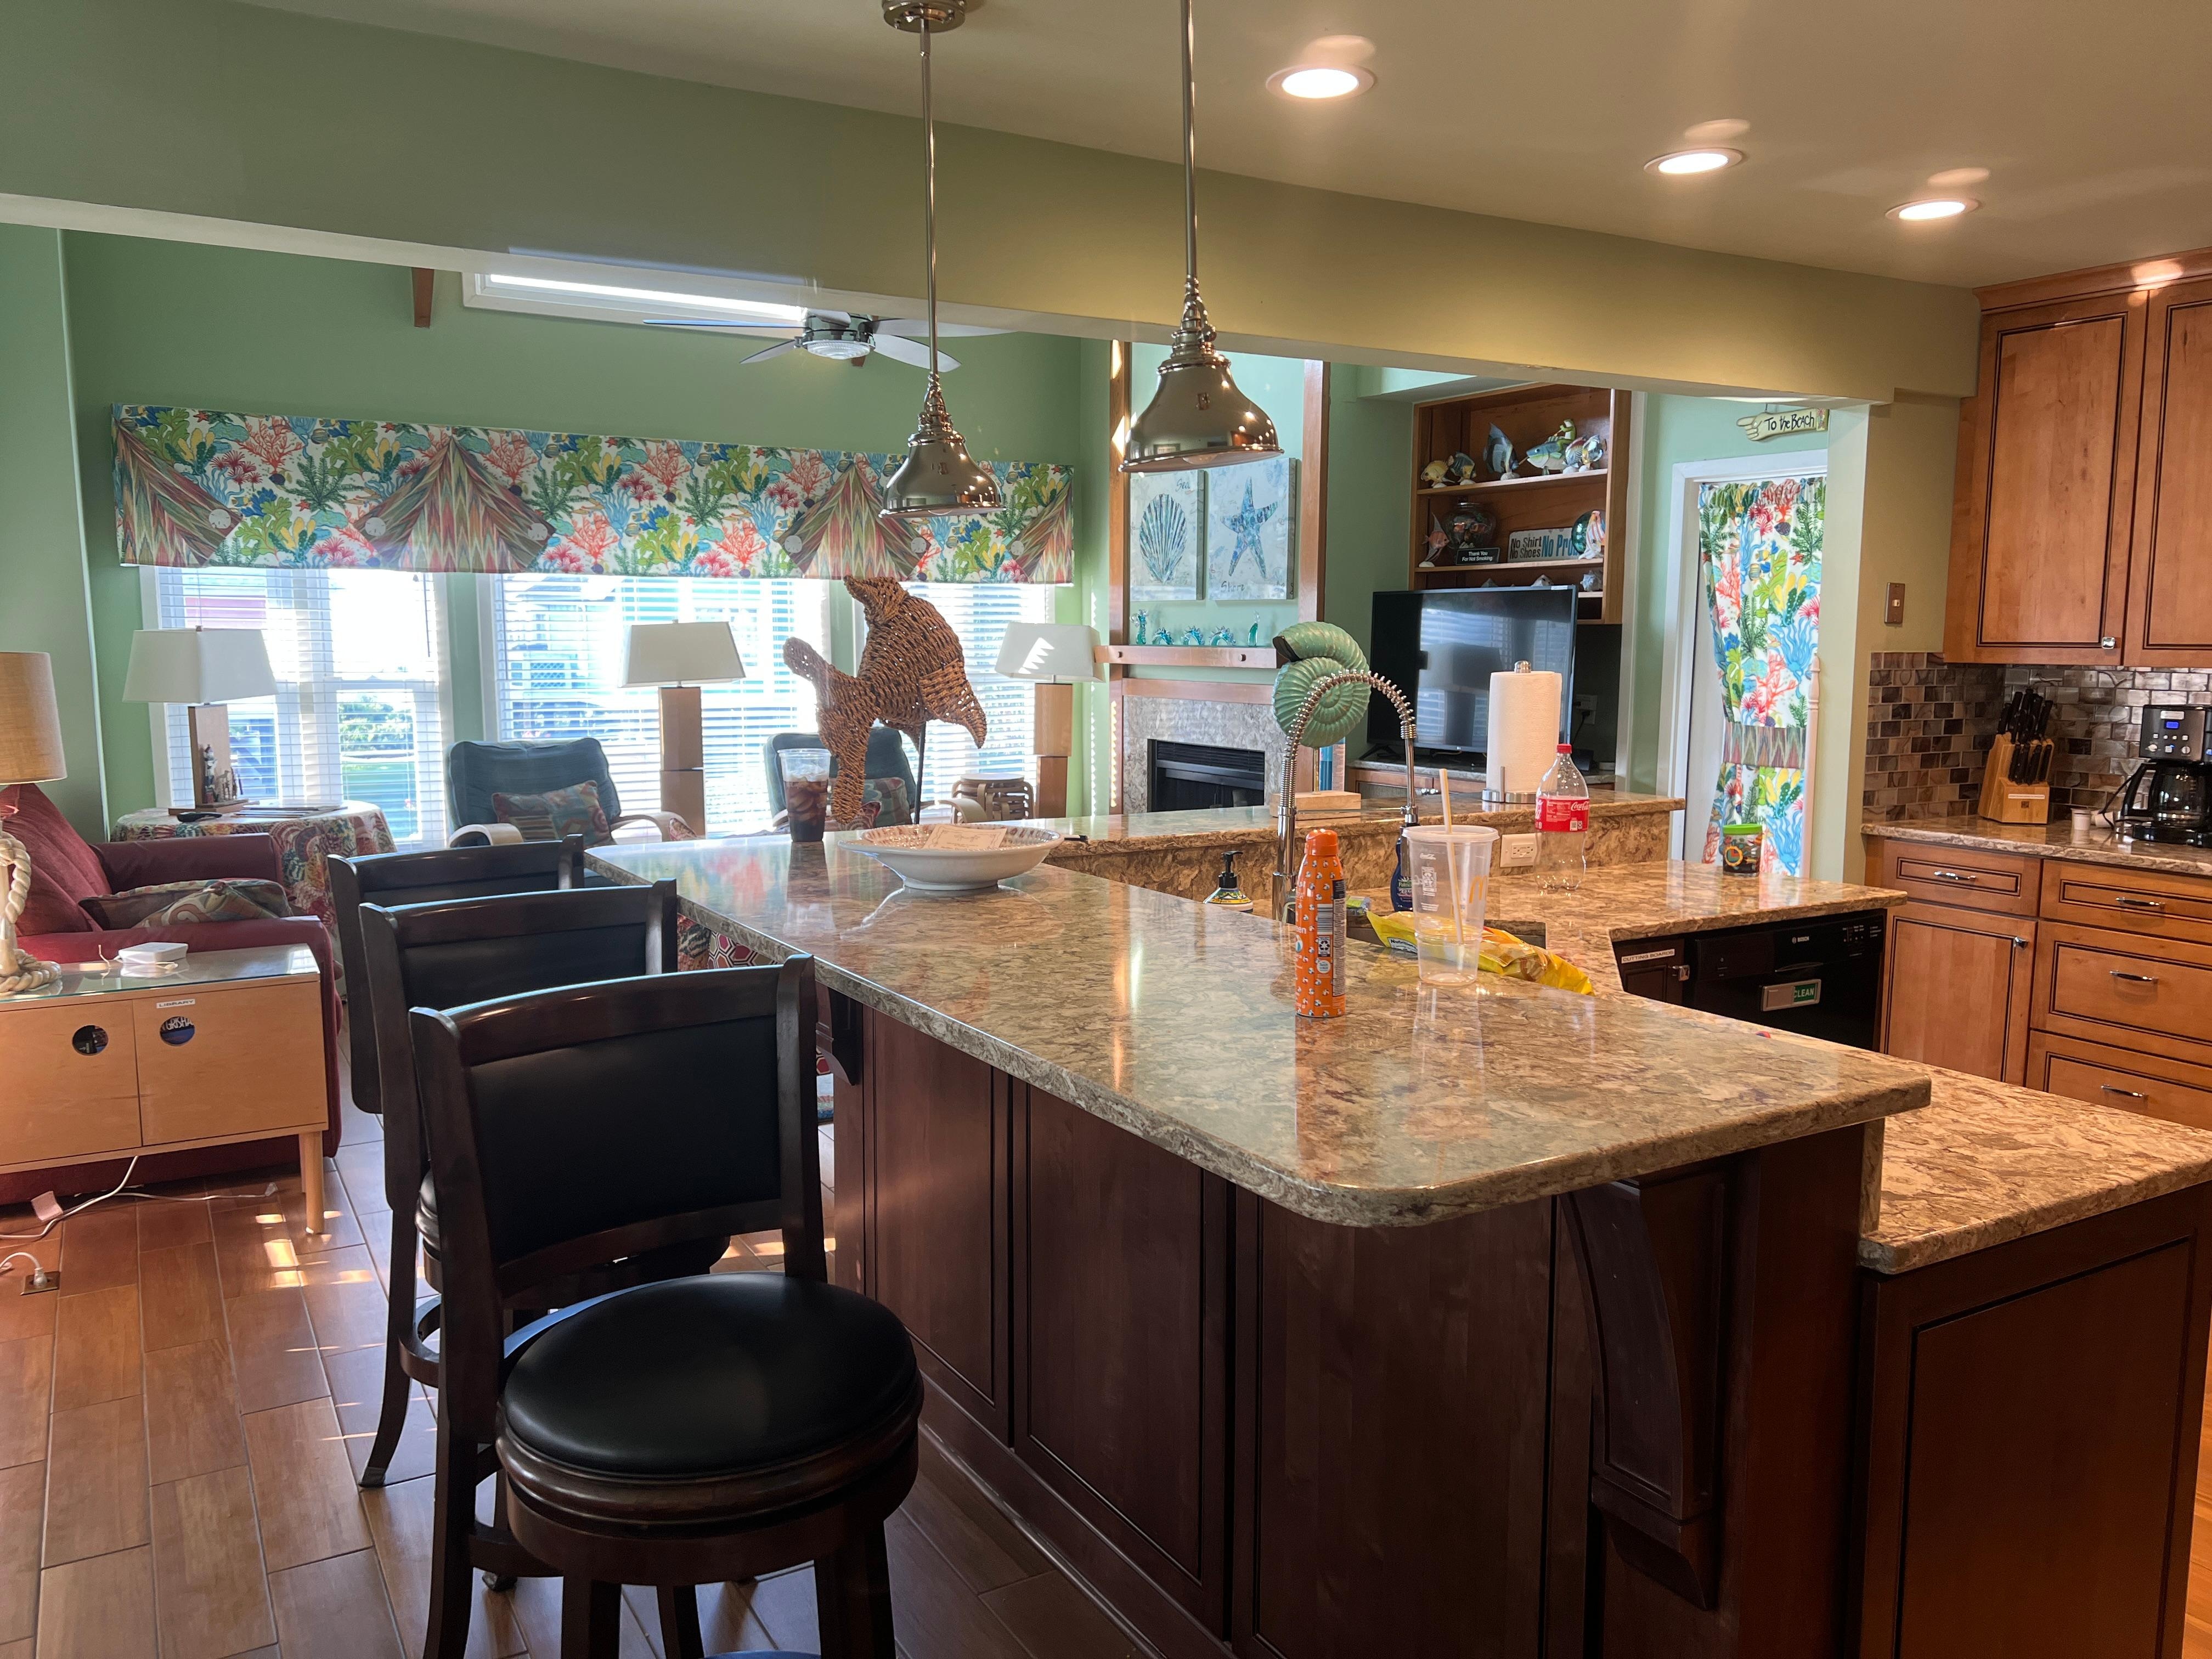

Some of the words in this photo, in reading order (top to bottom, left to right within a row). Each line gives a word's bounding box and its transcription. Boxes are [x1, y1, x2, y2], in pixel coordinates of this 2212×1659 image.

[1764, 417, 1777, 431] To
[1780, 415, 1791, 432] the
[1511, 538, 1520, 549] No
[1522, 536, 1542, 548] Shirt
[1542, 535, 1554, 558] No
[1556, 534, 1578, 556] Pro
[1510, 549, 1519, 559] No
[1520, 547, 1541, 558] Shoes
[1622, 954, 1649, 962] CUTTING
[1650, 950, 1674, 958] BOARDS
[1793, 988, 1814, 997] CLEAN
